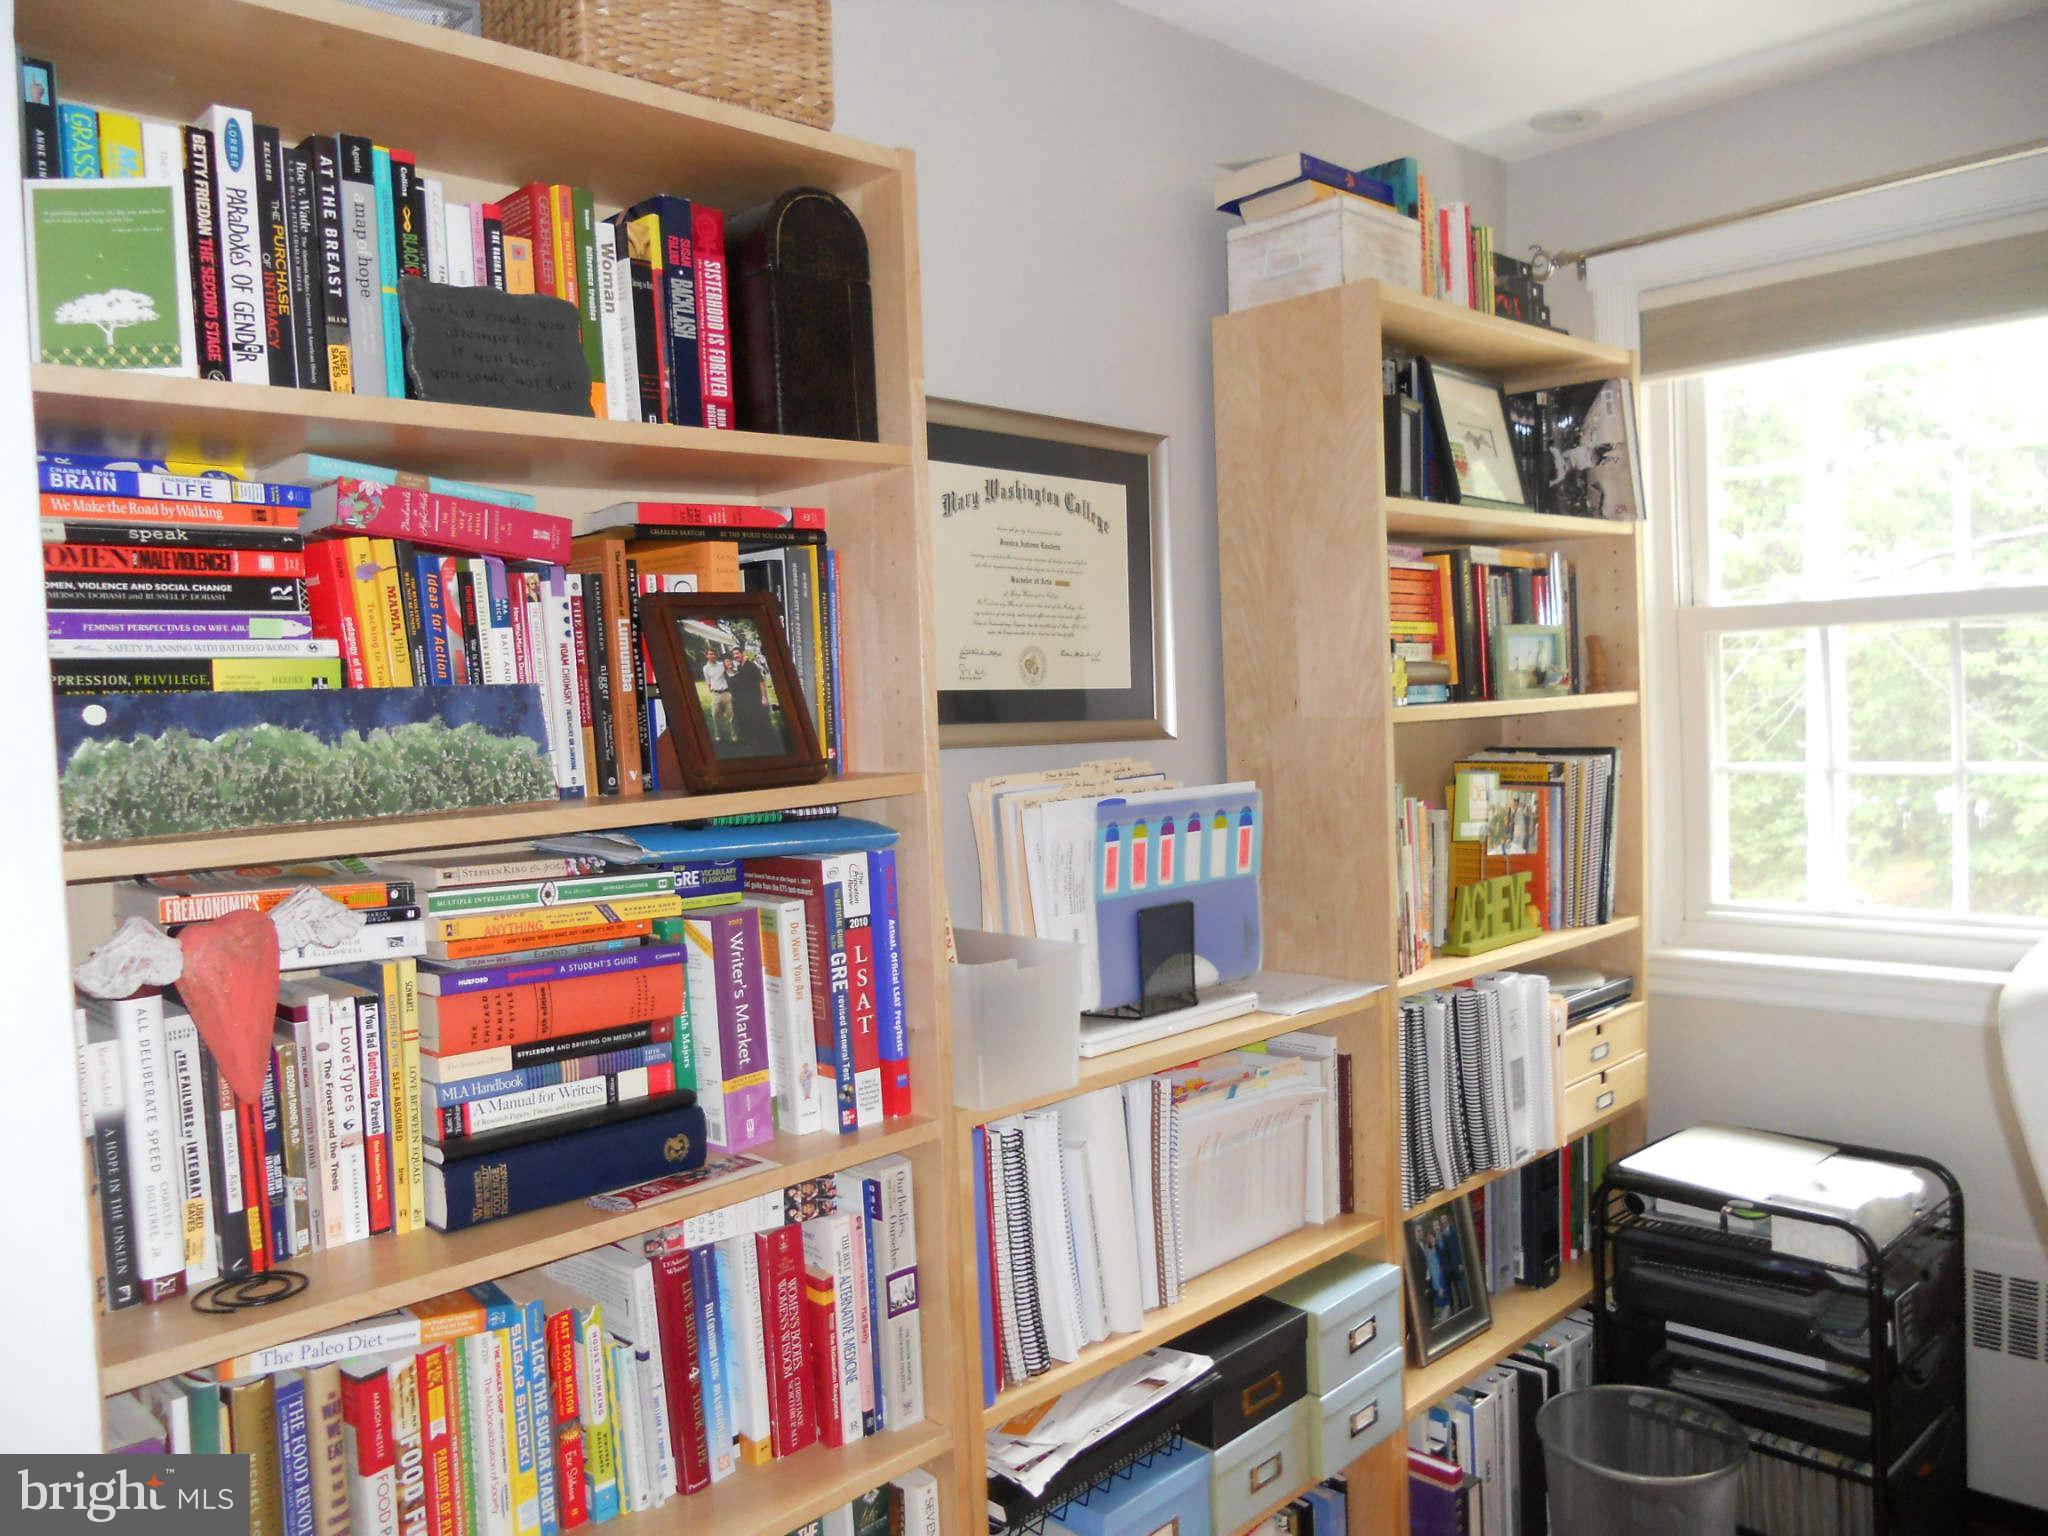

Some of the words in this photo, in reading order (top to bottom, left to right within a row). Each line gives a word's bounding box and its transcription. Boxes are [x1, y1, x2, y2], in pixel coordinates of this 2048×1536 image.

[191, 134, 208, 177] BETTY
[228, 123, 242, 169] LORBER
[263, 141, 273, 181] ZELIZER
[319, 155, 334, 186] AT
[400, 167, 409, 196] Collins
[195, 180, 213, 236] FRIEDAN
[271, 201, 281, 221] THE
[322, 193, 337, 219] THE
[198, 239, 214, 264] THE
[261, 253, 271, 269] OF
[324, 228, 342, 298] BREAST
[232, 275, 253, 294] OF
[272, 225, 290, 316] PURCHASE
[600, 242, 617, 314] Woman
[201, 267, 218, 317] SECOND
[703, 261, 722, 331] SISTERHOOD
[264, 271, 281, 349] INTIMACY
[671, 278, 697, 340] BACKLASH
[205, 322, 222, 361] STAGE
[707, 333, 725, 346] IS
[330, 347, 341, 378] SAVES
[339, 350, 349, 375] USED
[708, 349, 728, 397] FOREVER
[49, 472, 118, 493] BRAIN
[161, 481, 214, 499] LIFE
[50, 498, 71, 511] We
[73, 500, 101, 514] Make
[103, 501, 128, 514] the
[129, 502, 159, 516] Road
[160, 503, 176, 519] by
[176, 504, 225, 521] Walking
[941, 490, 980, 519] Mary
[984, 478, 1061, 517] Washington
[1063, 500, 1111, 545] College
[128, 528, 190, 543] speak
[427, 573, 440, 609] Ideas
[82, 622, 127, 633] FEMINIST
[128, 622, 192, 634] PERSPECTIVES
[193, 623, 209, 633] ON
[431, 613, 442, 632] for
[571, 600, 581, 628] THE
[434, 636, 449, 678] Action
[559, 643, 571, 666] NOAM
[574, 630, 586, 665] DEBT
[617, 618, 634, 692] Lumumba
[561, 668, 573, 706] CHOMSKY
[599, 665, 611, 700] nigger
[853, 871, 861, 905] Princeton
[165, 894, 261, 922] FREAKONOMICS
[849, 917, 869, 928] 2010
[484, 920, 544, 937] ANYTHING
[887, 919, 898, 951] Actual,
[560, 964, 566, 974] A
[568, 959, 612, 973] STUDENT'S
[614, 956, 639, 968] GUIDE
[729, 930, 747, 999] Writer's
[830, 953, 849, 993] GRE
[890, 952, 901, 985] Official
[404, 980, 415, 1012] SCHWARTZ
[853, 945, 874, 1034] LSAT
[892, 986, 903, 1008] LSAT
[136, 1008, 148, 1030] ALL
[364, 1014, 377, 1030] You
[365, 1003, 377, 1012] If
[838, 994, 849, 1026] revised
[366, 1032, 378, 1048] Had
[470, 1025, 478, 1046] THE
[517, 1046, 555, 1058] STYLEBOOK
[556, 1043, 571, 1054] AND
[573, 1039, 600, 1052] BRIEFING
[601, 1038, 612, 1047] ON
[614, 1034, 632, 1045] MEDIA
[633, 1031, 647, 1041] LAW
[734, 1004, 753, 1066] Market
[840, 1027, 850, 1060] General
[176, 1052, 188, 1073] THE
[323, 1059, 334, 1080] The
[339, 1026, 357, 1113] LoveTypes
[366, 1051, 381, 1099] Controlling
[408, 1065, 419, 1091] LOVE
[842, 1063, 853, 1081] Test
[139, 1039, 159, 1122] DELIBERATE
[443, 1086, 470, 1101] MLA
[470, 1074, 524, 1097] Handbook
[179, 1076, 193, 1127] FAILURES
[324, 1082, 336, 1117] Forest
[473, 1103, 486, 1116] A
[489, 1095, 536, 1114] Manual
[537, 1089, 557, 1105] for
[557, 1080, 603, 1099] Writers
[105, 1128, 114, 1136] A
[185, 1129, 193, 1138] OF
[326, 1119, 337, 1139] and
[368, 1100, 382, 1135] Parents
[410, 1094, 421, 1143] BETWEEN
[107, 1141, 119, 1174] HOPE
[148, 1129, 164, 1173] SPEED
[328, 1141, 339, 1159] the
[412, 1146, 422, 1184] EQUALS
[110, 1178, 121, 1192] IN
[329, 1160, 341, 1192] Trees
[111, 1196, 124, 1220] THE
[194, 1203, 206, 1229] USED
[113, 1225, 127, 1274] UNSEEN
[842, 1233, 850, 1252] THE
[888, 1213, 901, 1271] Ourselves
[842, 1252, 851, 1272] BEST
[682, 1279, 698, 1309] LIVE
[776, 1278, 789, 1330] WOMEN'S
[787, 1277, 800, 1328] WOMEN'S
[839, 1275, 856, 1336] ALTERNATIVE
[560, 1315, 570, 1339] FAST
[684, 1314, 700, 1357] RIGHT
[261, 1349, 294, 1368] The
[301, 1339, 344, 1361] Paleo
[348, 1334, 383, 1354] Diet
[510, 1323, 527, 1392] SUGAR
[530, 1337, 546, 1377] LICK
[563, 1344, 573, 1370] FOOD
[780, 1332, 793, 1379] WISDOM
[790, 1329, 802, 1371] BODIES
[843, 1338, 858, 1386] MEDICINE
[688, 1366, 701, 1380] 4
[372, 1391, 382, 1426] MARION
[534, 1381, 548, 1413] THE
[565, 1376, 576, 1414] NATION
[691, 1393, 706, 1432] YOUR
[375, 1428, 384, 1458] NESTLE
[515, 1394, 533, 1466] SHOCK!
[536, 1415, 552, 1466] SUGAR
[695, 1436, 708, 1467] TYPE
[377, 1475, 392, 1523] FOOD
[541, 1472, 556, 1523] HABIT
